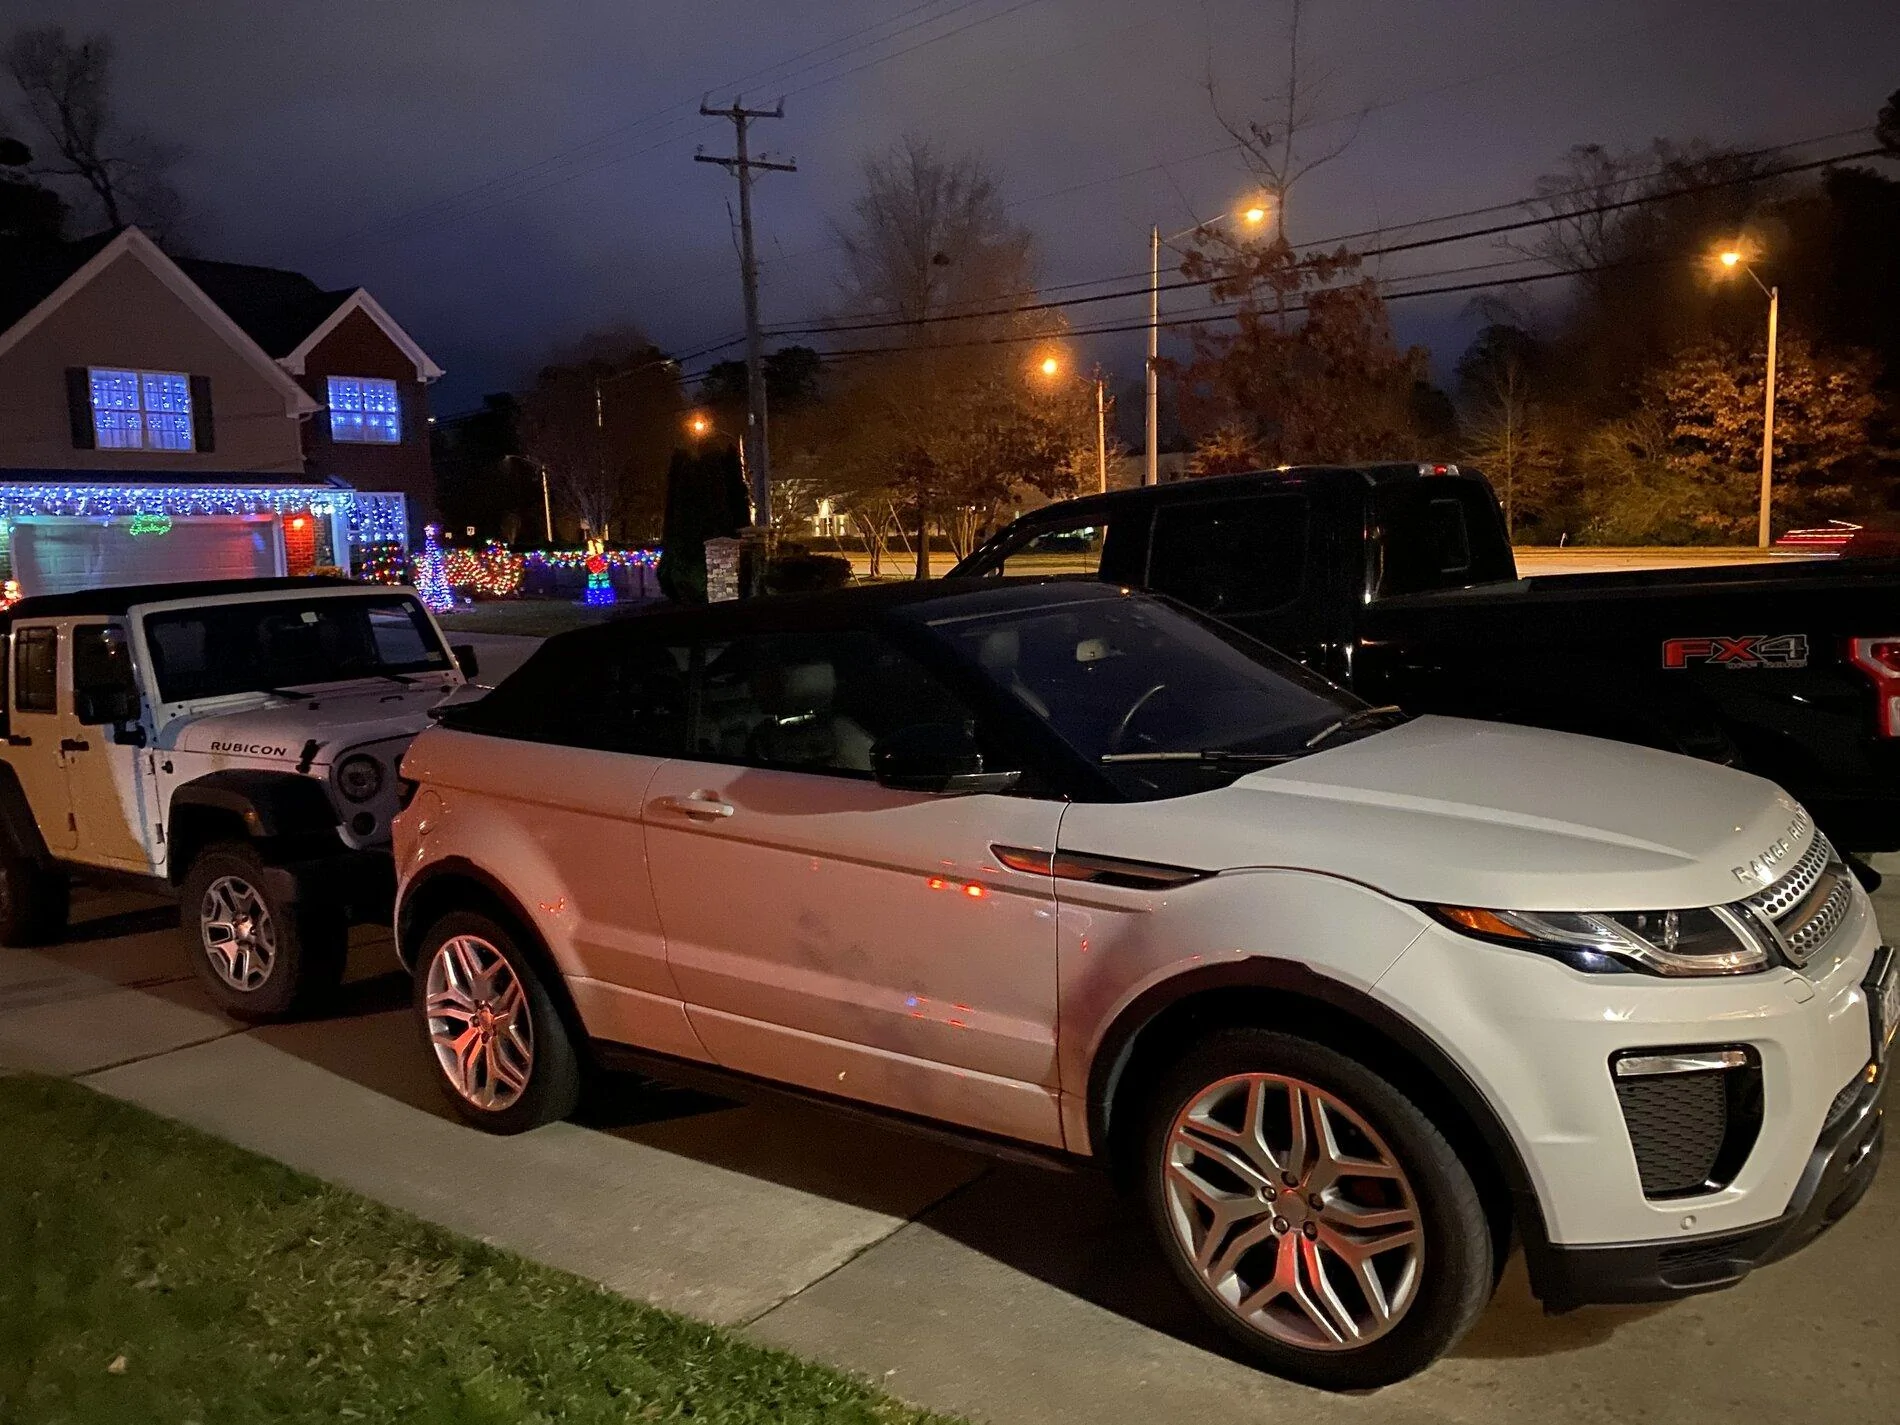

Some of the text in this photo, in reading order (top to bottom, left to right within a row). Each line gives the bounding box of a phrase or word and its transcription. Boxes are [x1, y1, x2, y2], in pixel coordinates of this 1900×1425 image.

[1662, 634, 1809, 669] FX4
[210, 741, 287, 756] RUBICON
[1731, 838, 1790, 884] RANGE
